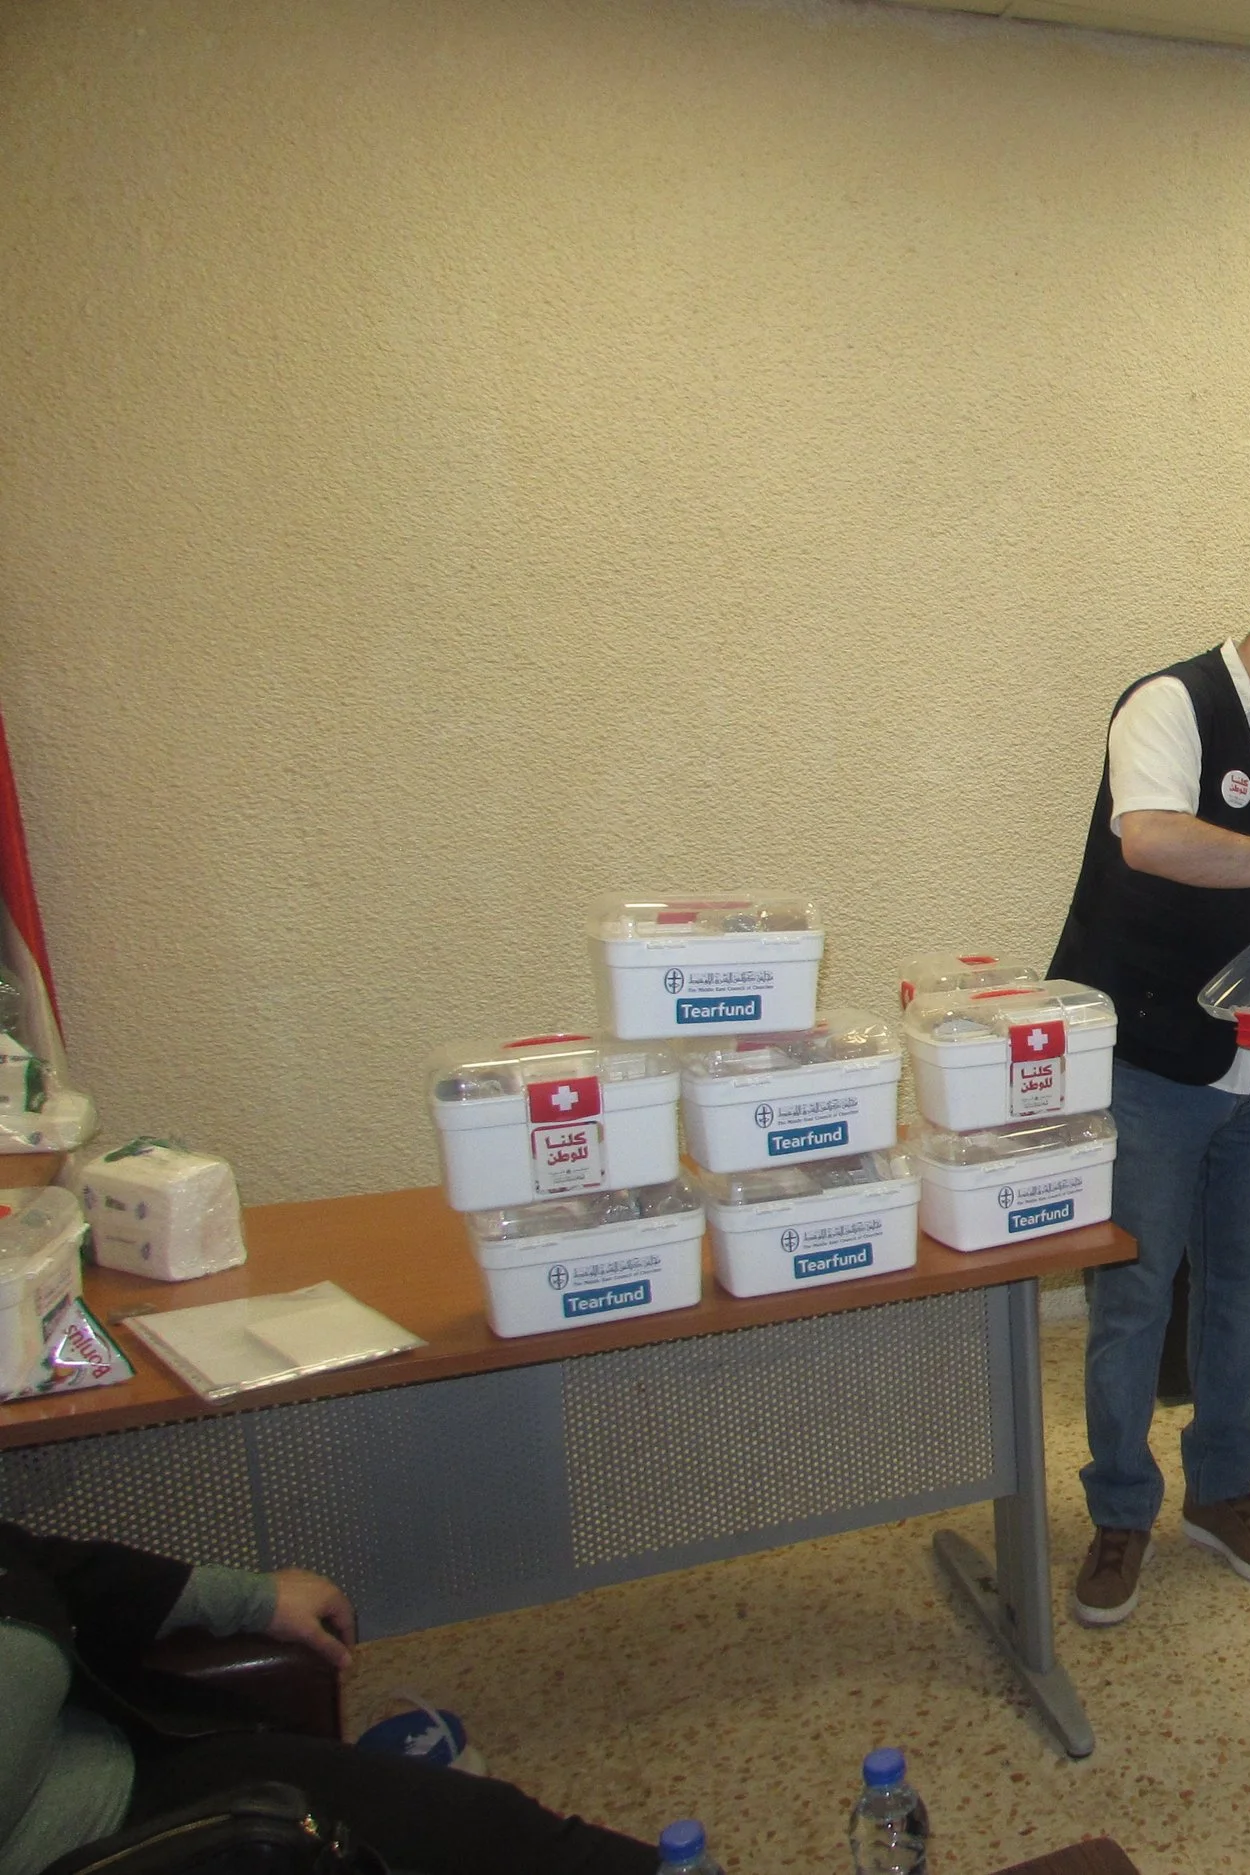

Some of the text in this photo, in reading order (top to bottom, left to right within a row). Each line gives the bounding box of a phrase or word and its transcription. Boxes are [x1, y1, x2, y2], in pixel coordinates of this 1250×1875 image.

[681, 1001, 755, 1019] Tearfund
[1020, 1064, 1053, 1080] كلنا
[1021, 1076, 1053, 1094] للوطن
[545, 1131, 587, 1149] كلنا
[772, 1127, 842, 1150] Tearfund
[547, 1145, 588, 1166] للوطن
[1012, 1204, 1069, 1228] Tearfund
[798, 1248, 867, 1273] Tearfund
[567, 1285, 644, 1312] Tearfund
